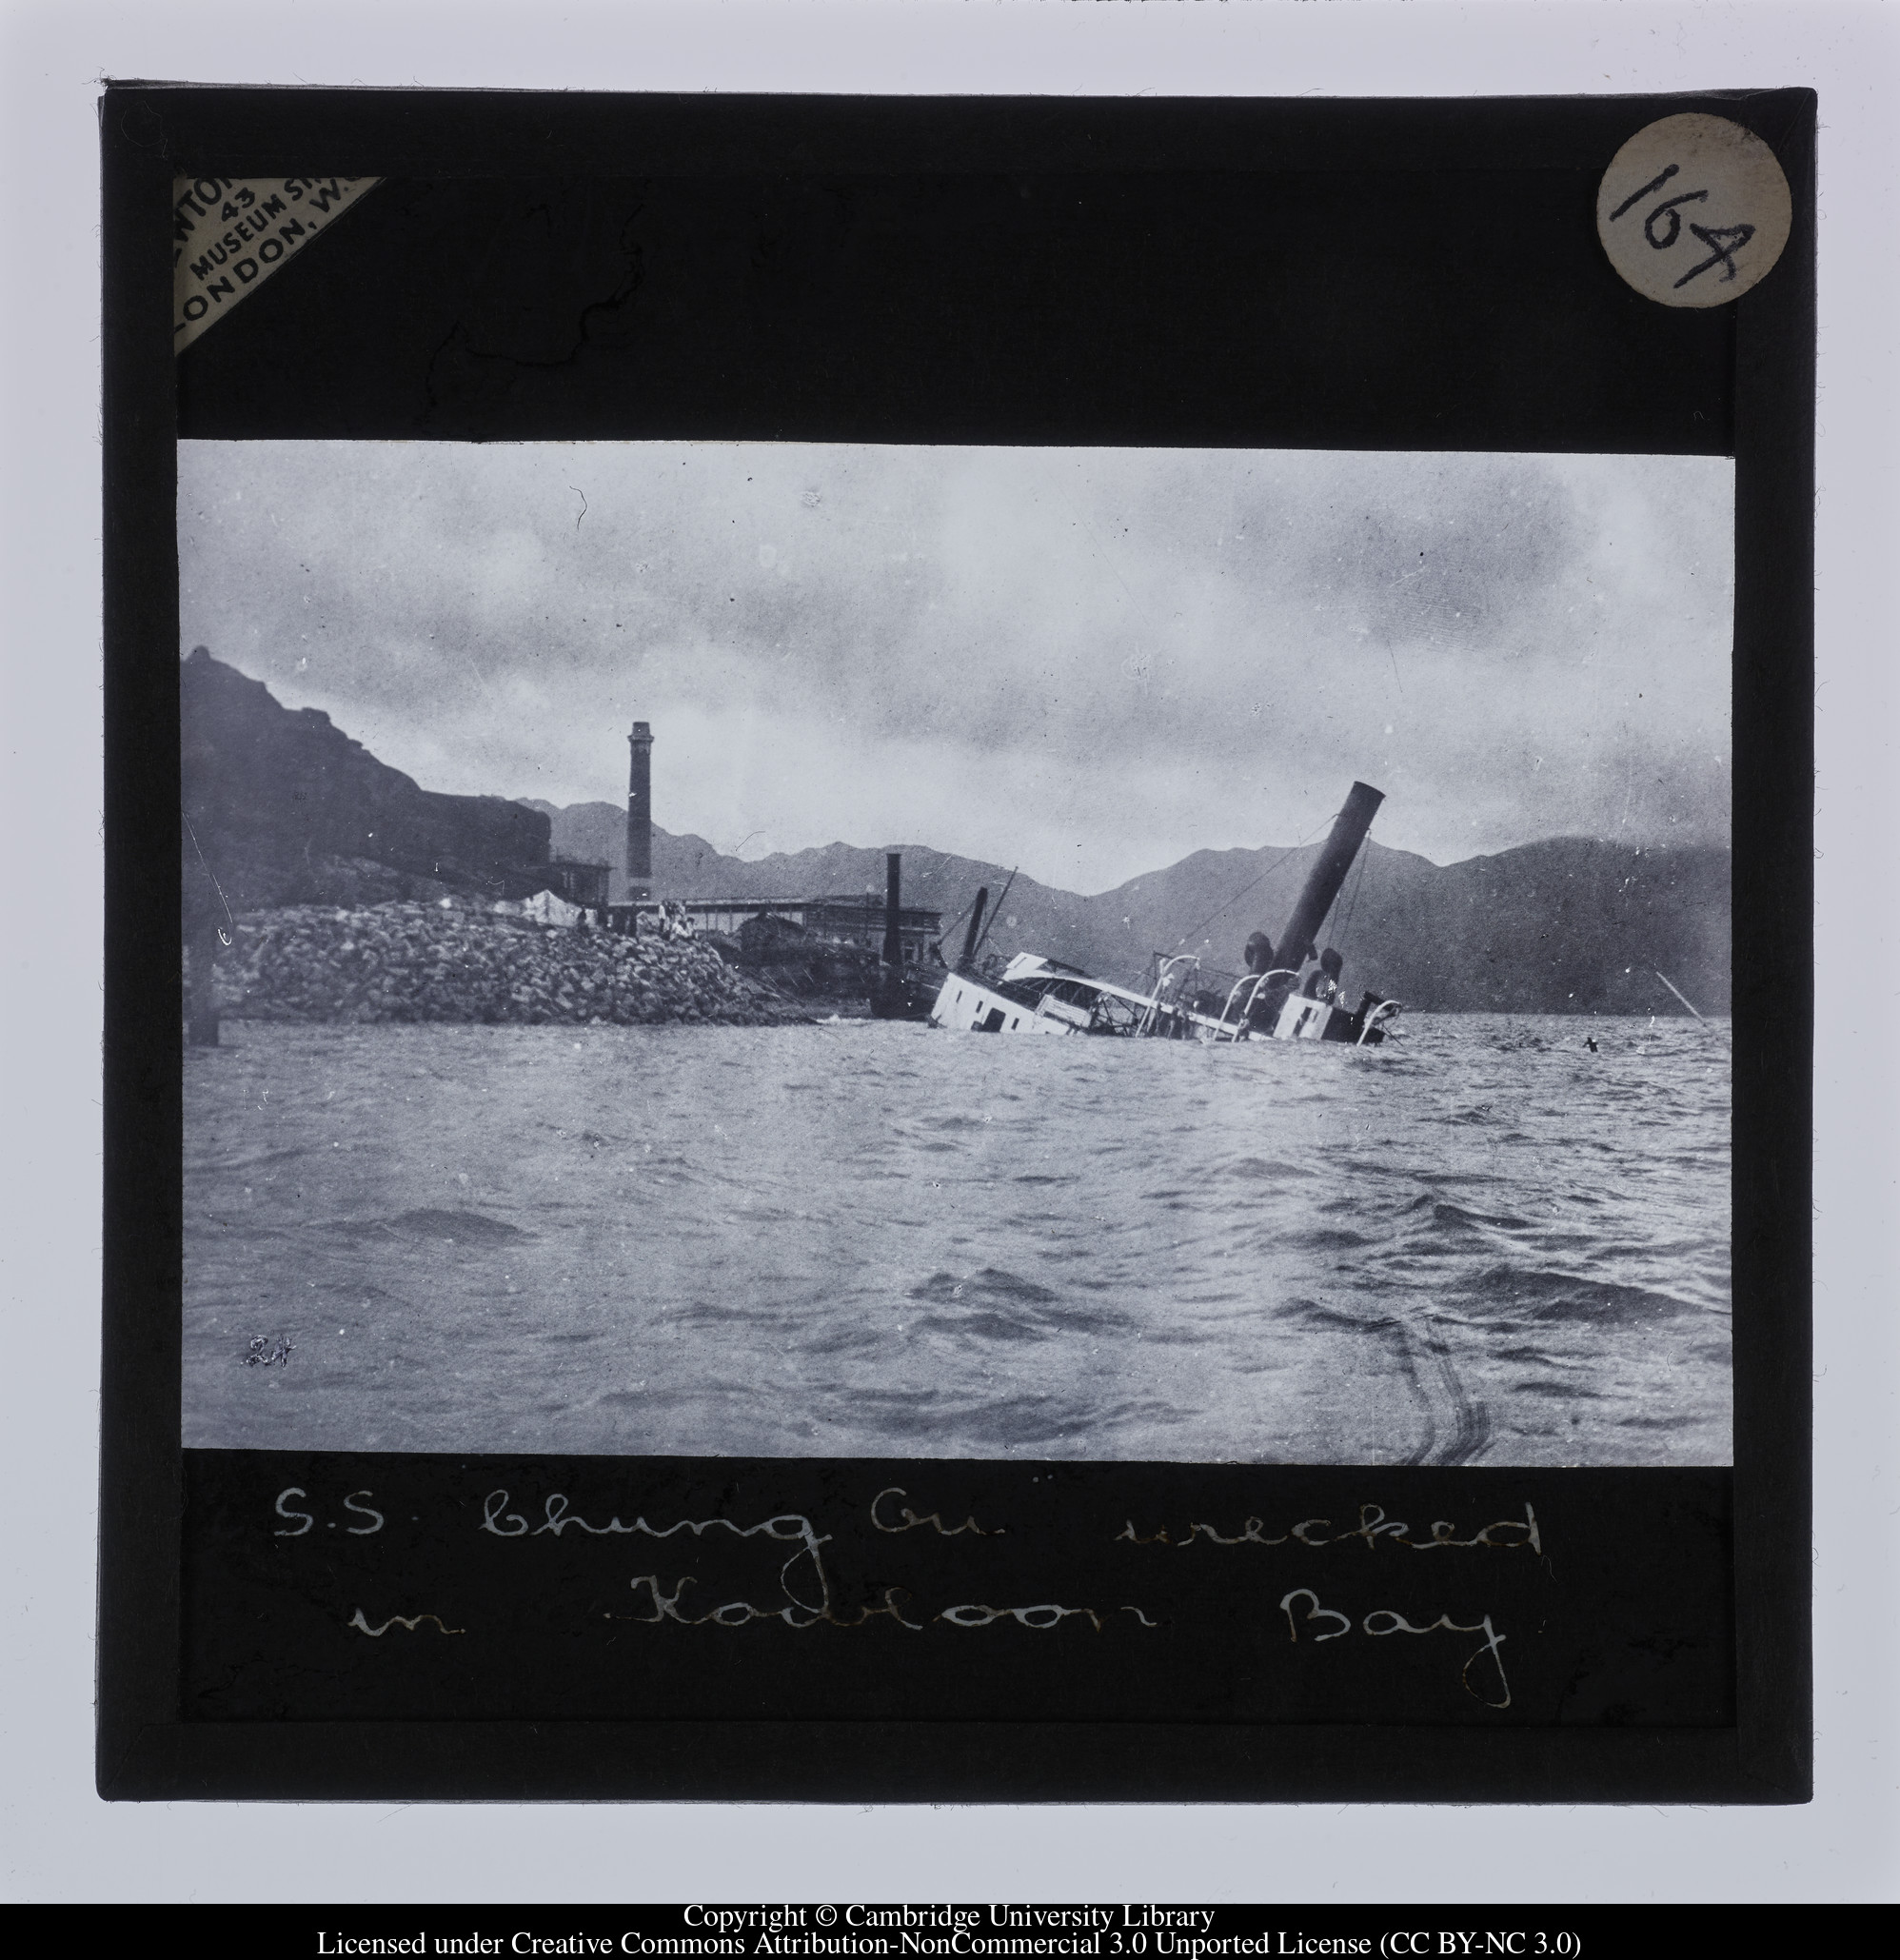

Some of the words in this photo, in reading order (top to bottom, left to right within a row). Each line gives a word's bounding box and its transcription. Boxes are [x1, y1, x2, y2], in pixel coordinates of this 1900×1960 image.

[189, 193, 287, 281] MUSEUM
[221, 187, 256, 222] 43
[1115, 1501, 1542, 1556] wrecked
[1278, 1588, 1514, 1710] Bay
